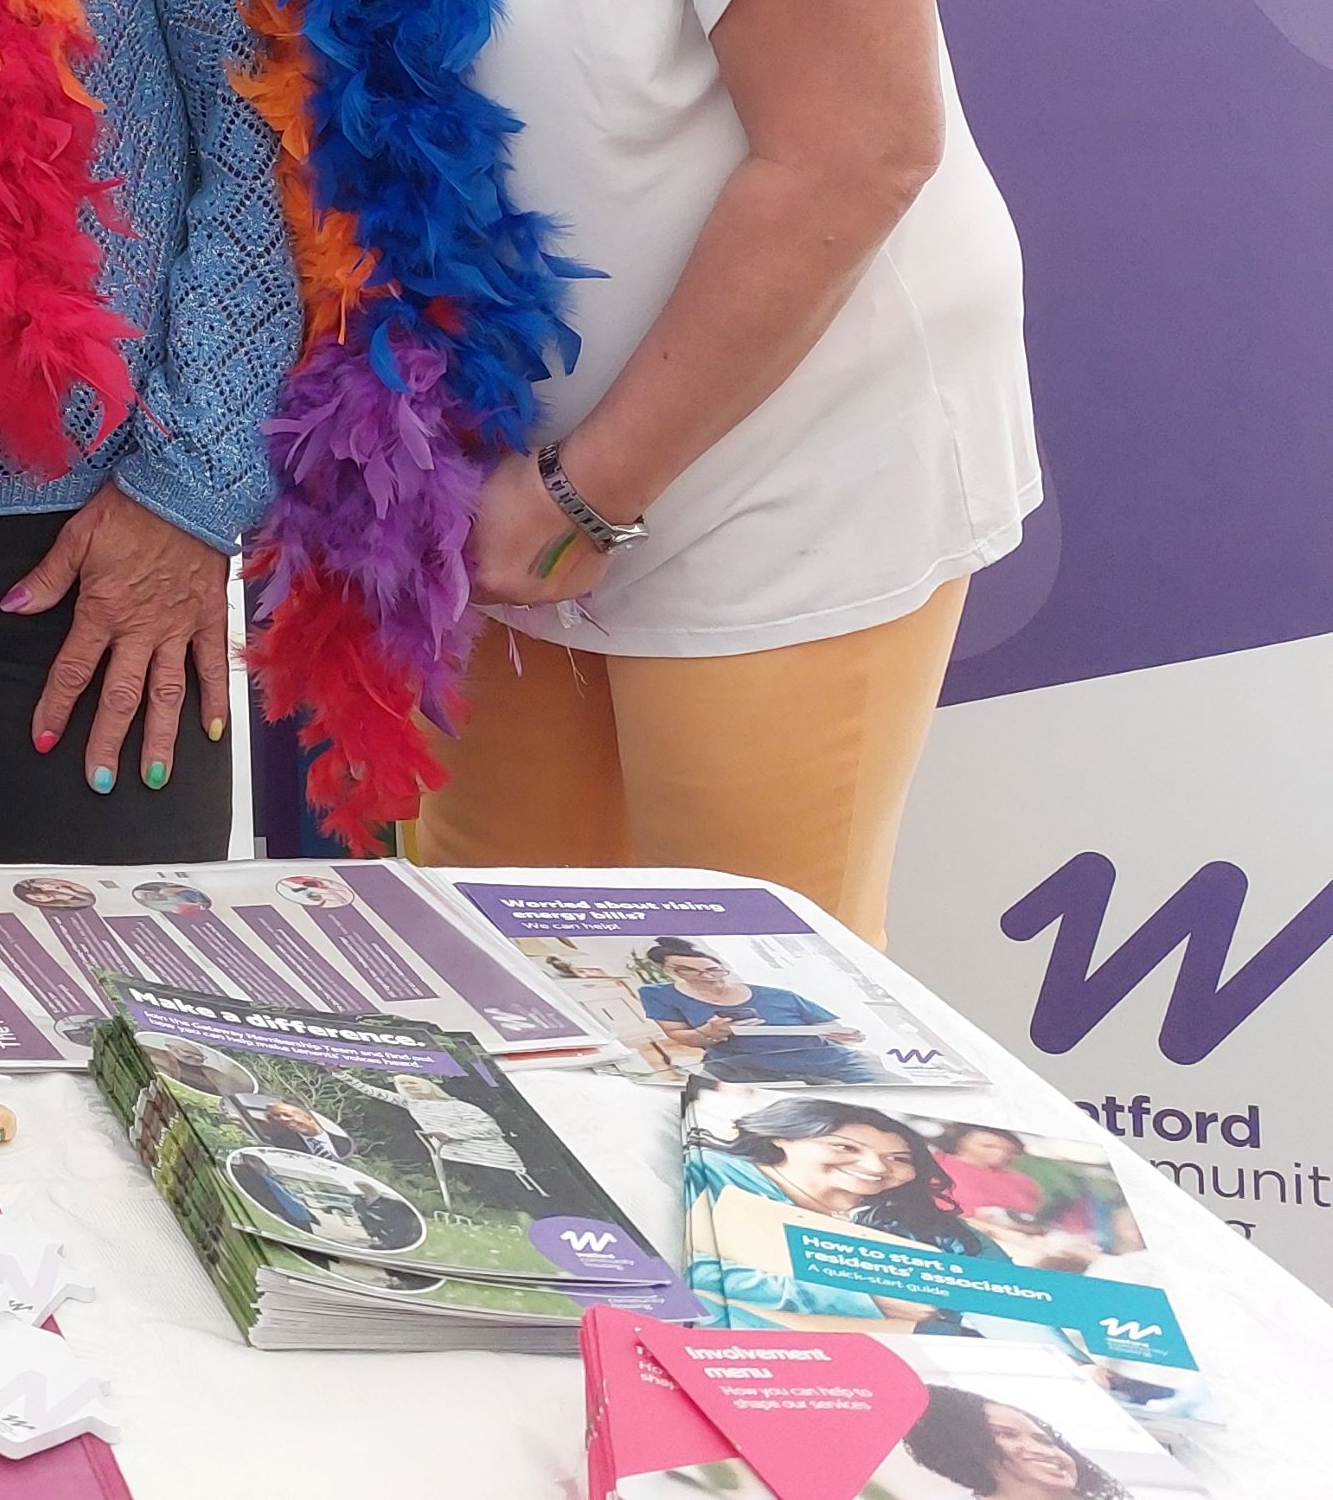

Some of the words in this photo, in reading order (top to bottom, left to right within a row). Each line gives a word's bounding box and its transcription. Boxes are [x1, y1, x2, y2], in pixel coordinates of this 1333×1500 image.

[500, 898, 592, 909] Worried
[594, 900, 661, 911] about
[661, 900, 727, 913] rising
[512, 911, 588, 922] energy
[590, 910, 647, 921] bills?
[520, 921, 551, 930] We
[552, 922, 582, 930] can
[582, 921, 622, 931] help!
[128, 987, 218, 1019] Make
[219, 1011, 243, 1024] a
[245, 1013, 427, 1047] difference.
[1073, 1095, 1261, 1150] tford
[1147, 1155, 1333, 1208] munit
[801, 1235, 855, 1254] How
[858, 1244, 886, 1260] to
[889, 1252, 946, 1271] start
[949, 1264, 964, 1274] a
[804, 1250, 915, 1279] residents'
[919, 1270, 1053, 1302] association
[807, 1263, 821, 1274] A
[822, 1267, 906, 1290] quick-start
[905, 1282, 950, 1298] guide
[685, 1345, 833, 1362] Involvement
[638, 1361, 664, 1375] Ho
[703, 1365, 774, 1380] menu
[720, 1385, 759, 1397] How
[762, 1386, 789, 1398] you
[789, 1387, 819, 1397] can
[819, 1385, 852, 1399] help
[852, 1388, 874, 1398] to
[733, 1399, 782, 1411] shape
[782, 1400, 808, 1410] our
[809, 1400, 873, 1411] services
